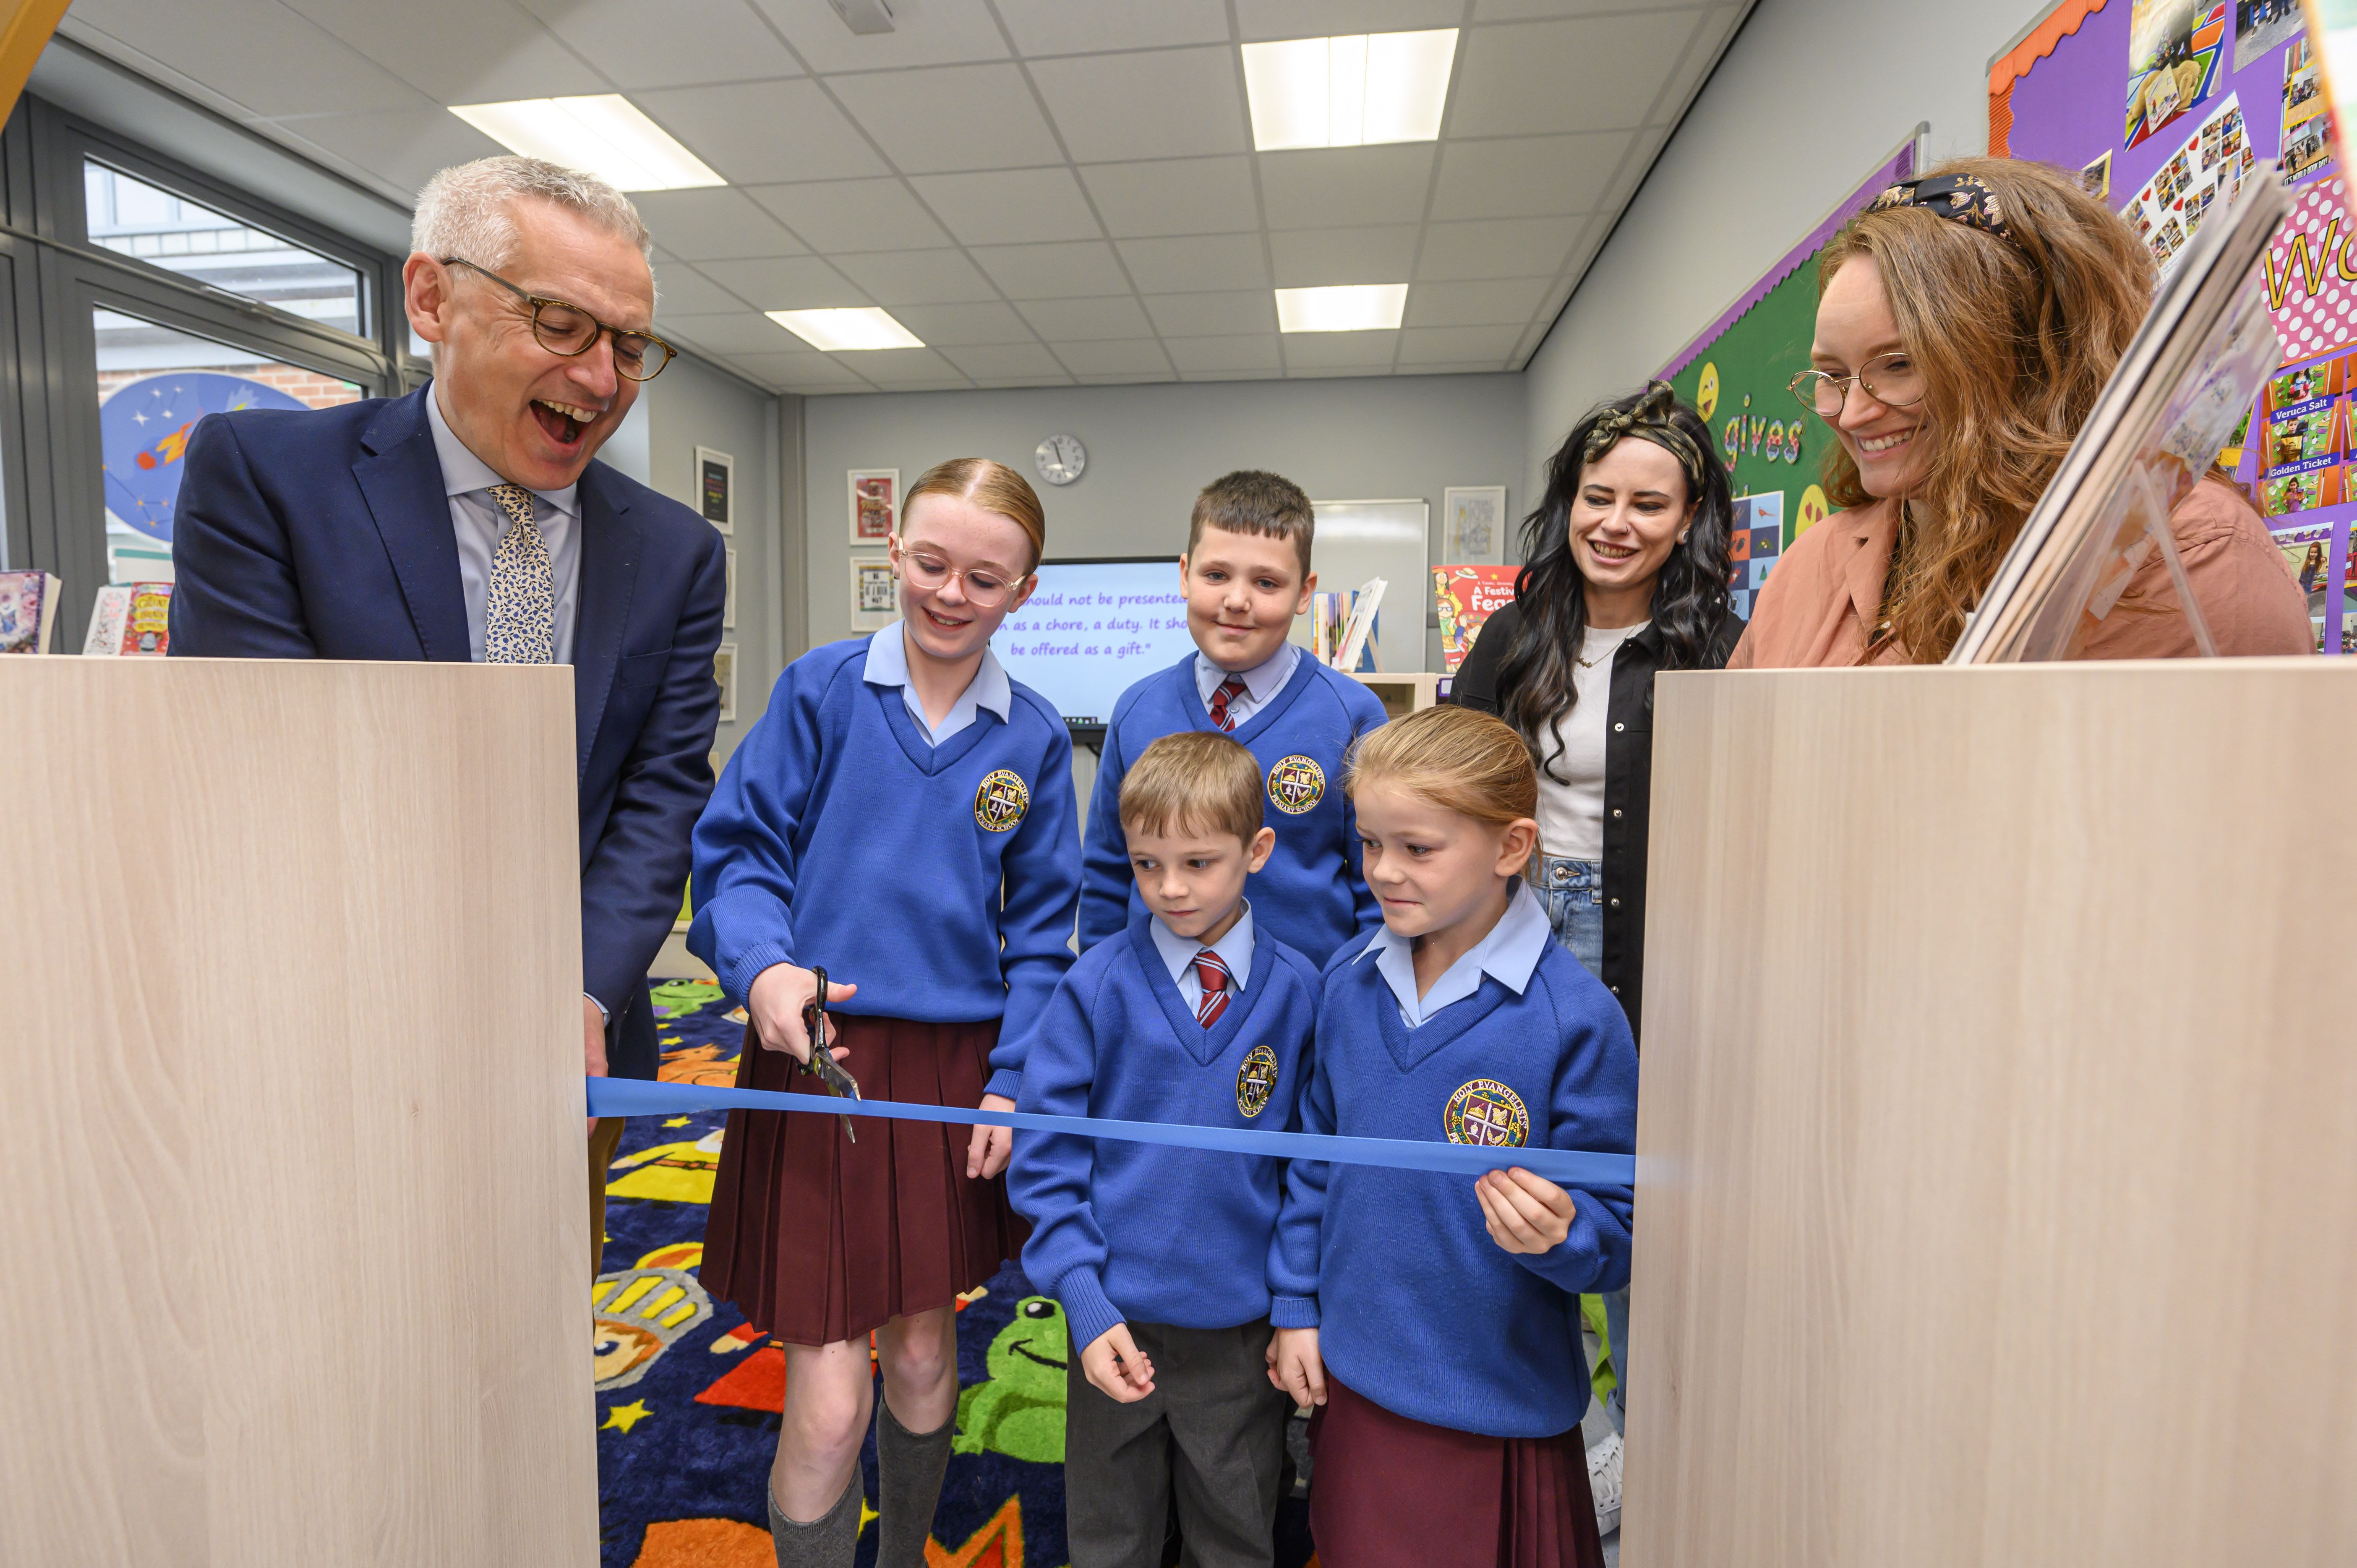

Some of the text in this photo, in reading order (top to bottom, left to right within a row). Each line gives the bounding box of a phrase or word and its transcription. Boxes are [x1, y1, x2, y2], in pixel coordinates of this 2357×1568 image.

[2276, 399, 2327, 420] Veruca Salt
[1724, 393, 1804, 472] gives
[2271, 457, 2332, 477] Golden Ticket
[1023, 592, 1063, 606] hould
[1068, 594, 1092, 605] not
[1098, 592, 1112, 605] be
[1474, 586, 1483, 595] A
[1471, 594, 1514, 611] Fea
[1013, 621, 1027, 631] as
[1032, 621, 1040, 631] a
[1046, 618, 1088, 632] chore,
[1093, 621, 1101, 630] a
[1107, 617, 1143, 634] duty.
[1149, 618, 1160, 629] It
[1010, 642, 1025, 655] be
[1031, 642, 1078, 655] offered
[1084, 646, 1098, 655] as
[1104, 646, 1112, 655] a
[1273, 759, 1287, 775] HOLY
[981, 772, 995, 789] HOLY
[1271, 794, 1317, 813] PRIMARY SCHOOL
[976, 810, 1019, 830] PRIMARY SCHOOL
[1241, 1052, 1252, 1072] HOLY
[1453, 1083, 1474, 1103] HOLY
[1449, 1132, 1462, 1144] PR
